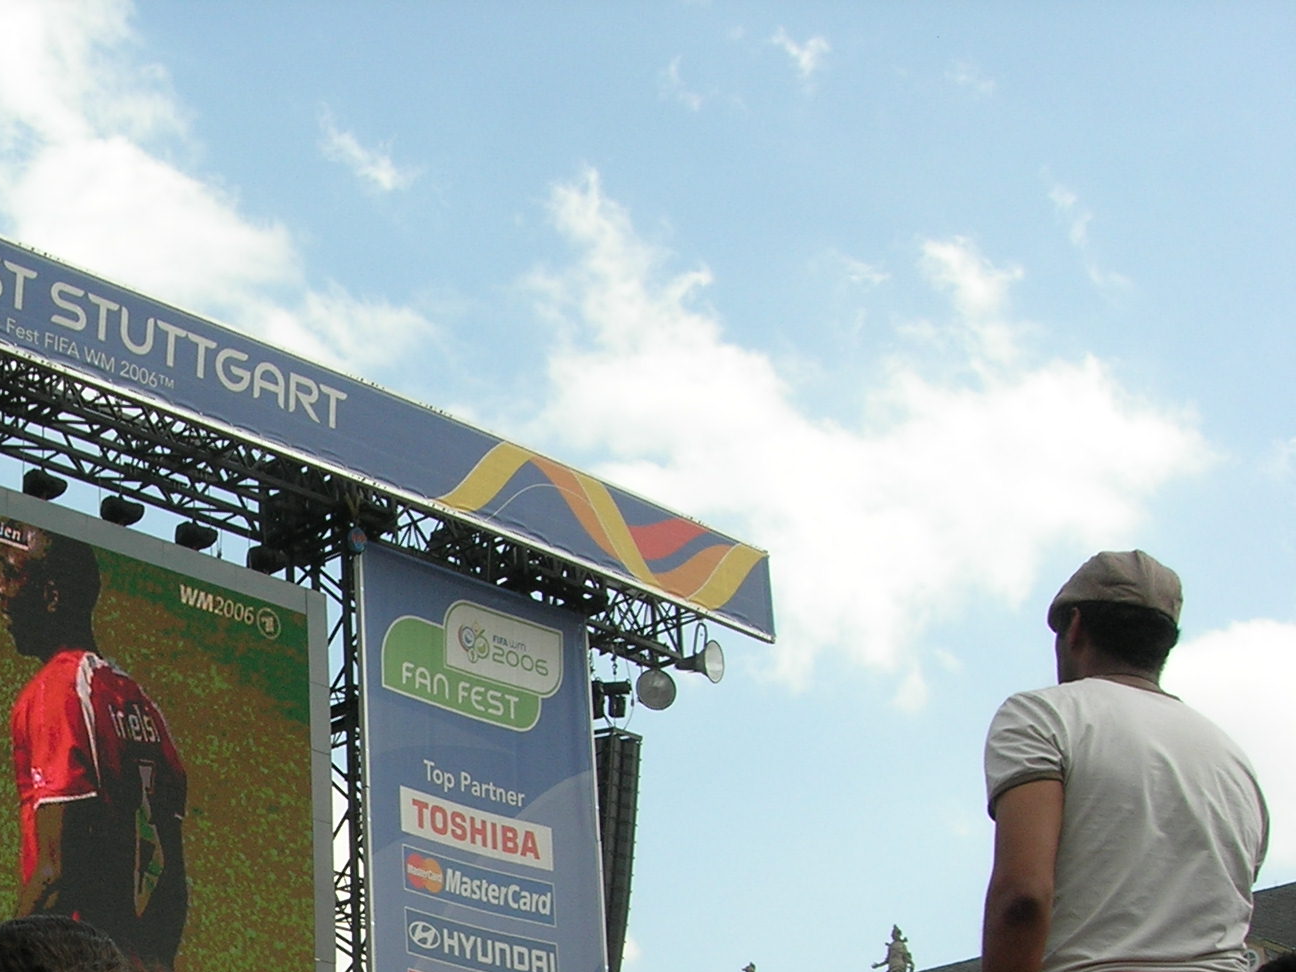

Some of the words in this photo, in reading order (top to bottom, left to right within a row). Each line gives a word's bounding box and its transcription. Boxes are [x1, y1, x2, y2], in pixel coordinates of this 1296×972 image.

[6, 317, 39, 345] Fest
[44, 332, 80, 359] FIFA
[84, 346, 115, 373] WM
[50, 281, 347, 429] STUTTGART
[180, 584, 255, 625] WM2006
[492, 644, 549, 676] 2006
[401, 661, 449, 699] FAN
[458, 683, 520, 720] FEST
[424, 759, 455, 793] Top
[460, 771, 526, 807] Partner
[412, 798, 541, 860] TOSHIBA
[445, 868, 551, 916] MasterCard
